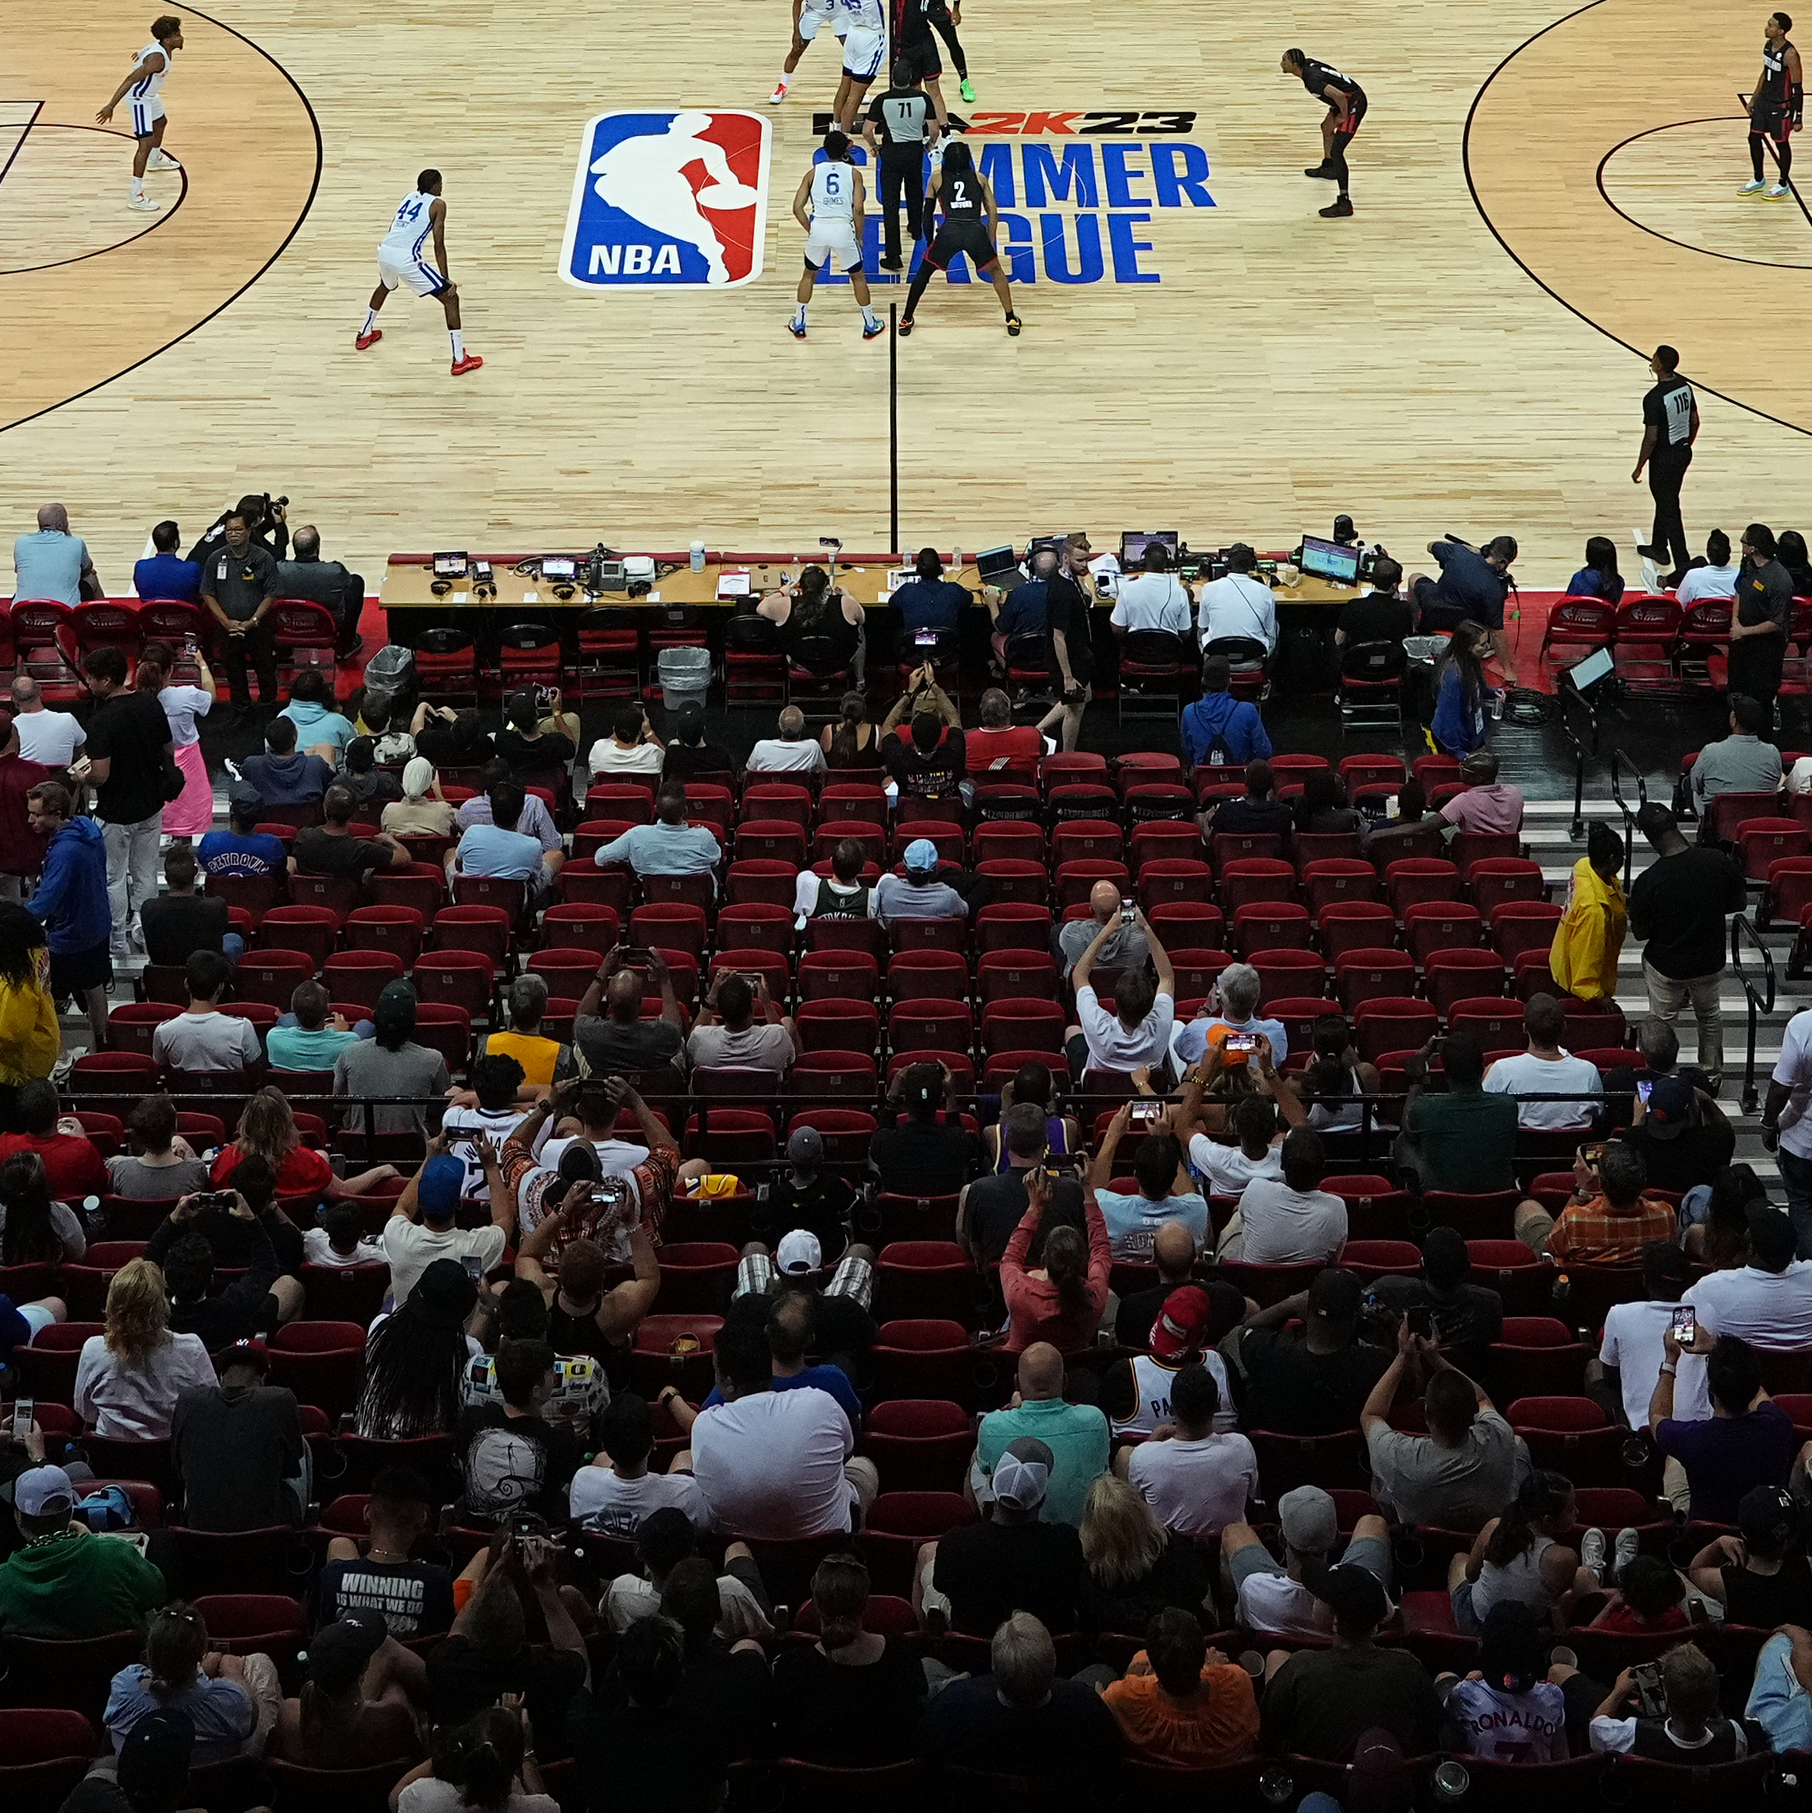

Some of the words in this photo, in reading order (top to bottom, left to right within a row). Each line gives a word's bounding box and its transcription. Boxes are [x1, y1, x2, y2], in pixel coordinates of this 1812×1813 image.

[897, 102, 913, 118] 71
[826, 174, 839, 194] 6
[953, 181, 967, 201] 2
[398, 199, 424, 221] 44
[588, 245, 682, 275] NBA
[340, 1572, 425, 1599] WINNING
[336, 1592, 345, 1604] IS
[345, 1593, 385, 1609] WHAT
[386, 1597, 404, 1612] WE
[406, 1599, 424, 1614] DO
[1470, 1711, 1553, 1738] RONALDO
